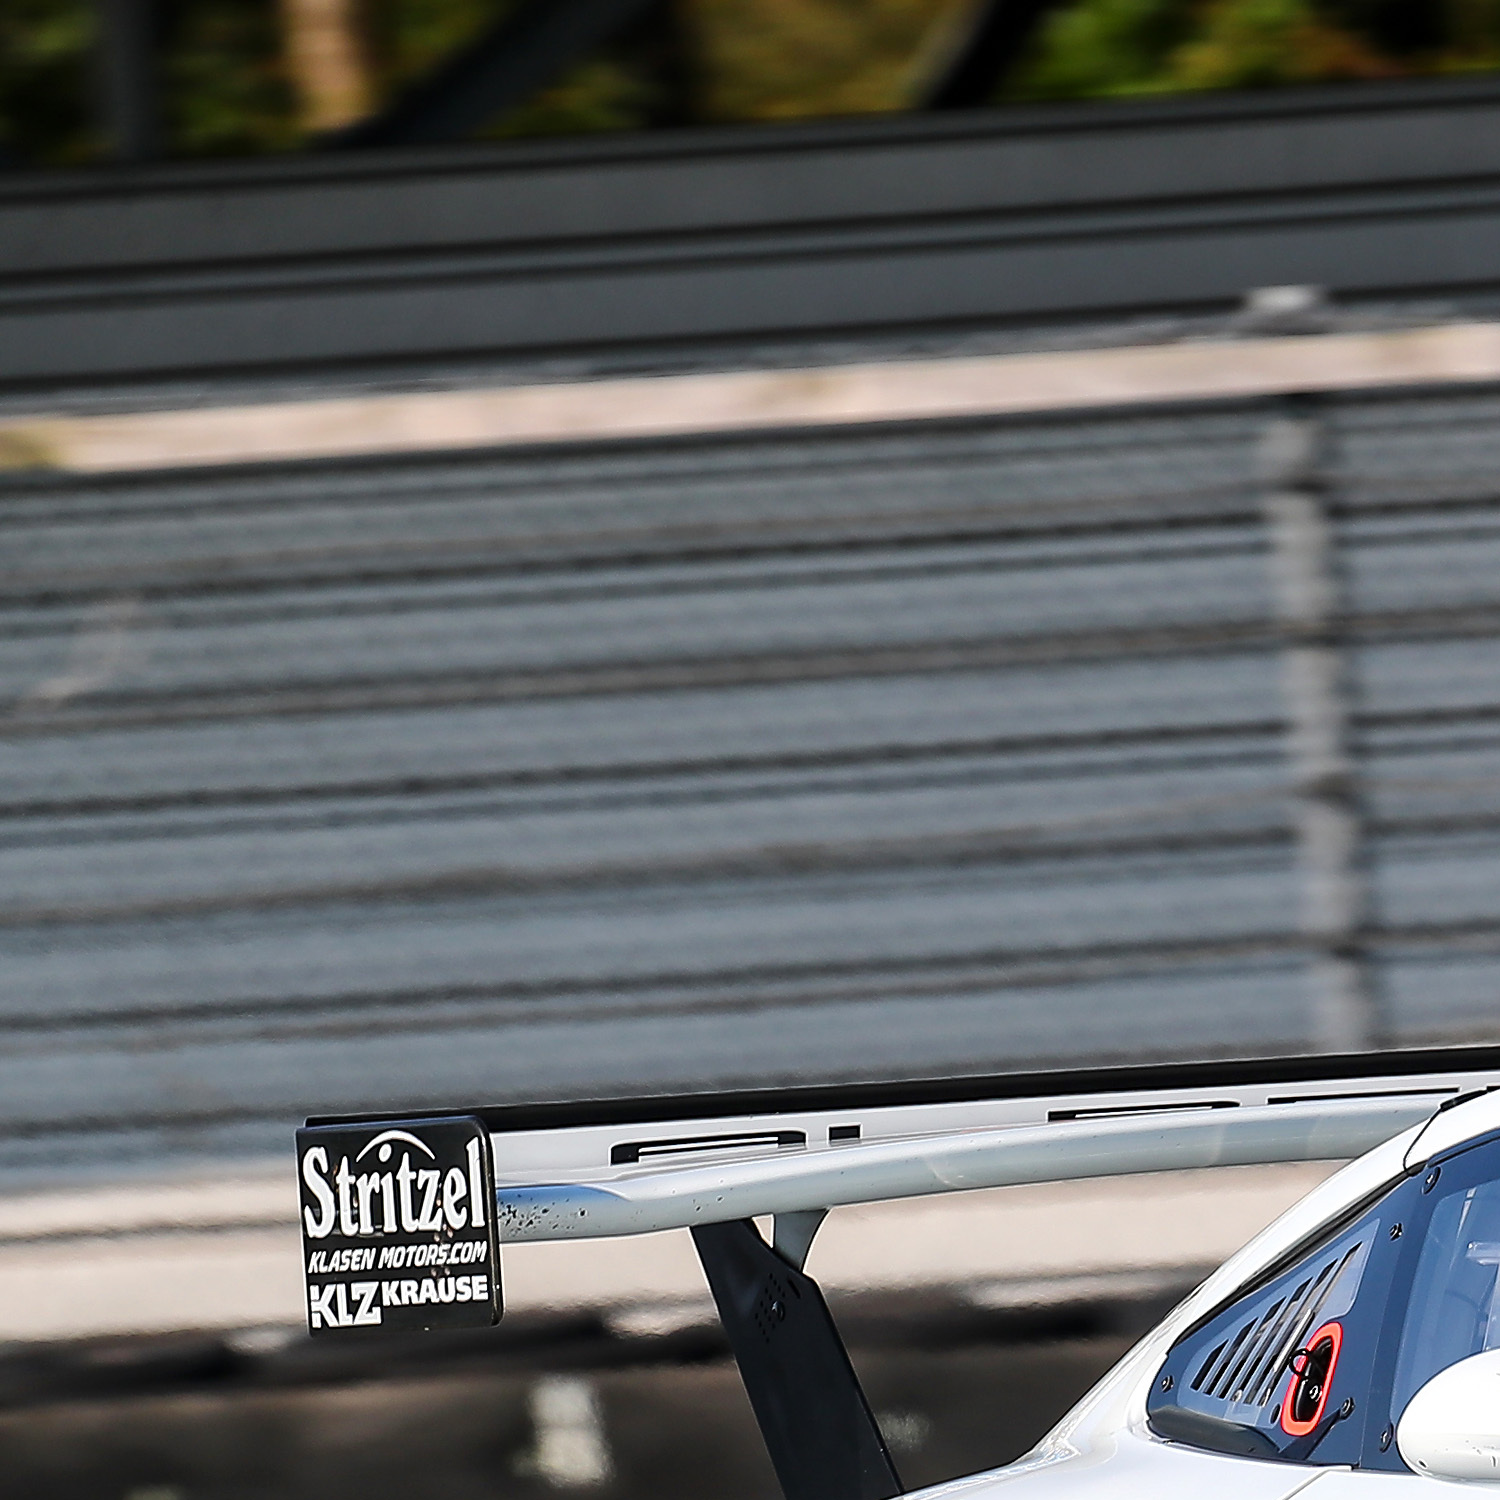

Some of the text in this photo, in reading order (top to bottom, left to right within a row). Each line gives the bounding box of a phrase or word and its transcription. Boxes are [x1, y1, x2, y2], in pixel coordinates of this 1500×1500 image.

[303, 1136, 486, 1239] Stritzel
[308, 1241, 488, 1274] KLASEN MOTORS.COM
[309, 1274, 490, 1329] KLZ KRAUSE
